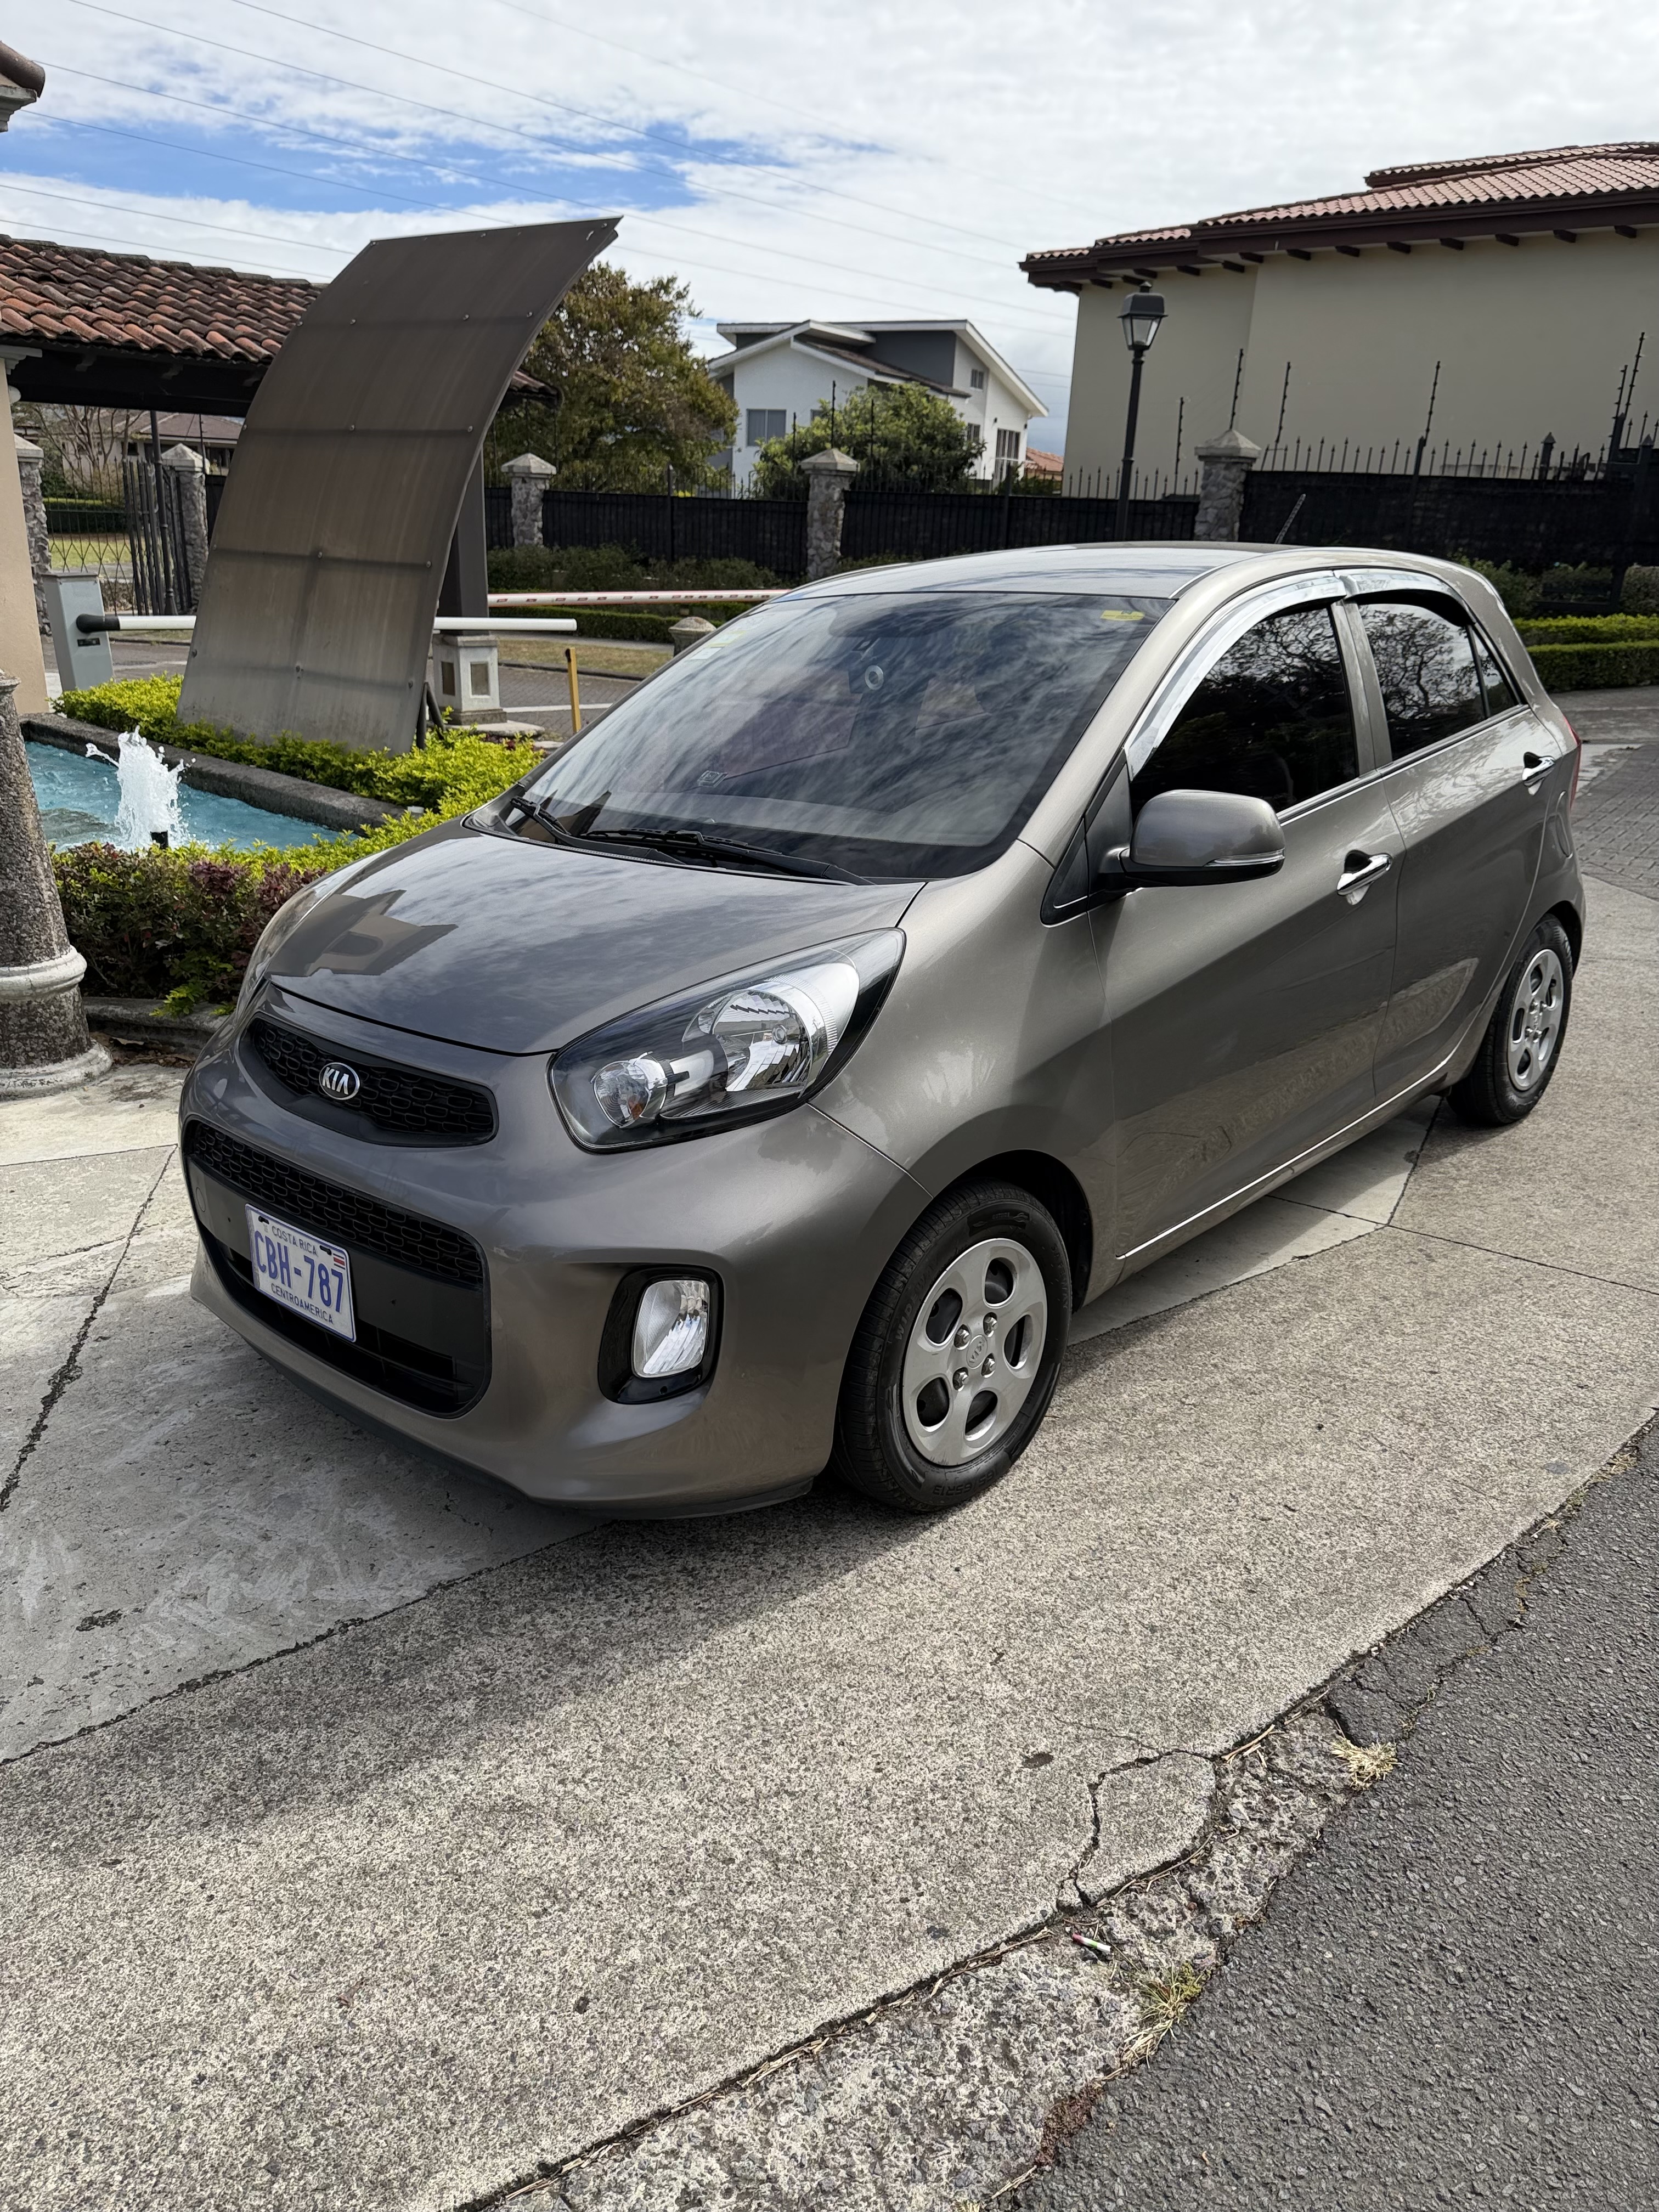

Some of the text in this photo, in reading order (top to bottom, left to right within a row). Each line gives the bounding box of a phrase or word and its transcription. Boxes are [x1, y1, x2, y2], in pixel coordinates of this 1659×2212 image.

[322, 1066, 349, 1095] KIA
[272, 1225, 319, 1257] COSTA RICA
[255, 1231, 343, 1313] CBH-787
[271, 1283, 334, 1325] CENTROAMERICA
[932, 1466, 998, 1497] 165/65R13
